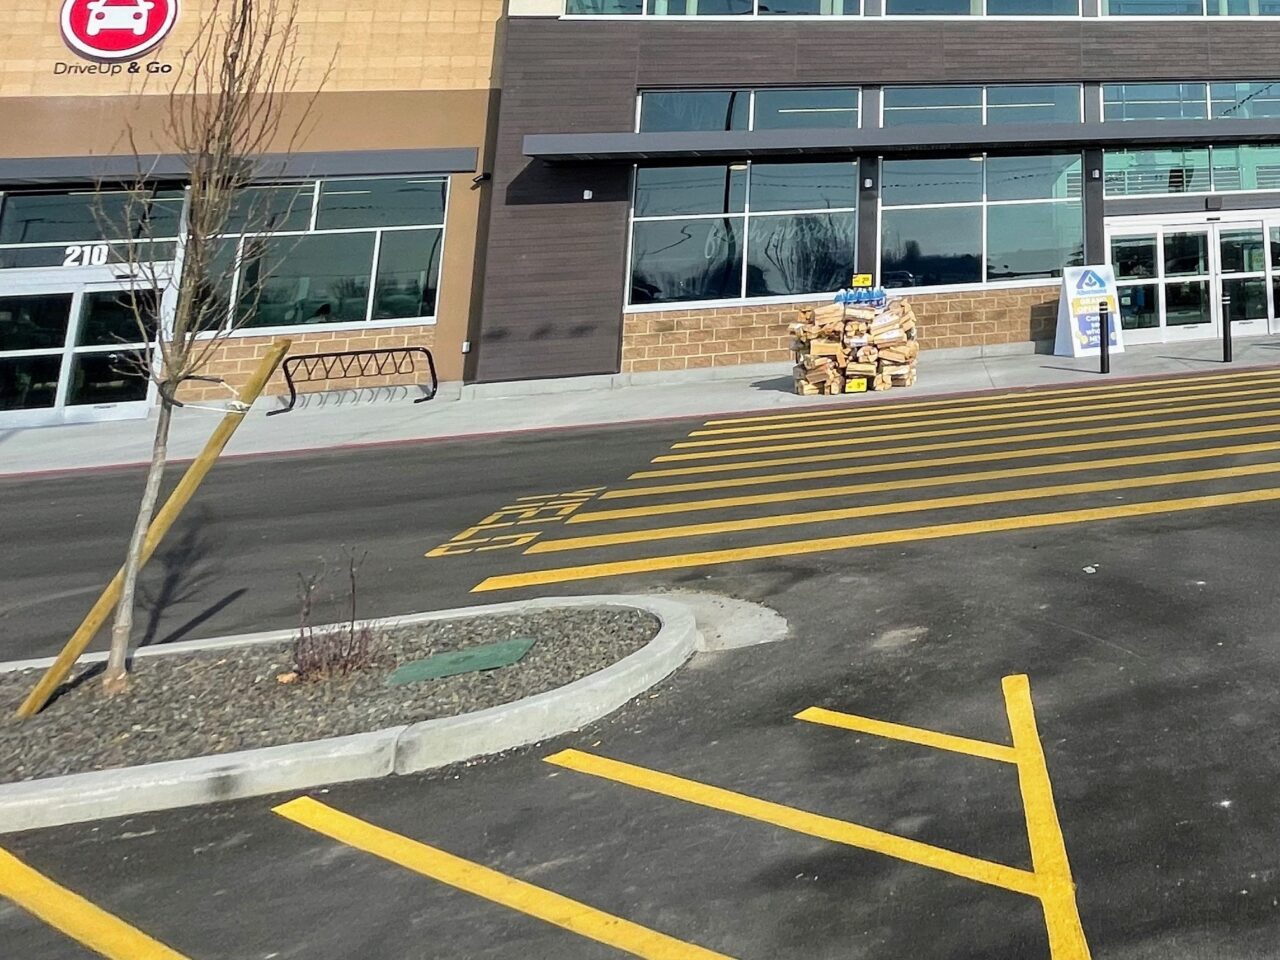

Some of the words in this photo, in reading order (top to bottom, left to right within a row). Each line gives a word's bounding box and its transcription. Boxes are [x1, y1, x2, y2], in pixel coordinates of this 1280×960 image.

[53, 62, 122, 77] DriveUp
[127, 61, 141, 74] &
[146, 61, 172, 74] Go
[63, 245, 109, 267] 210
[424, 486, 608, 558] YIELD
